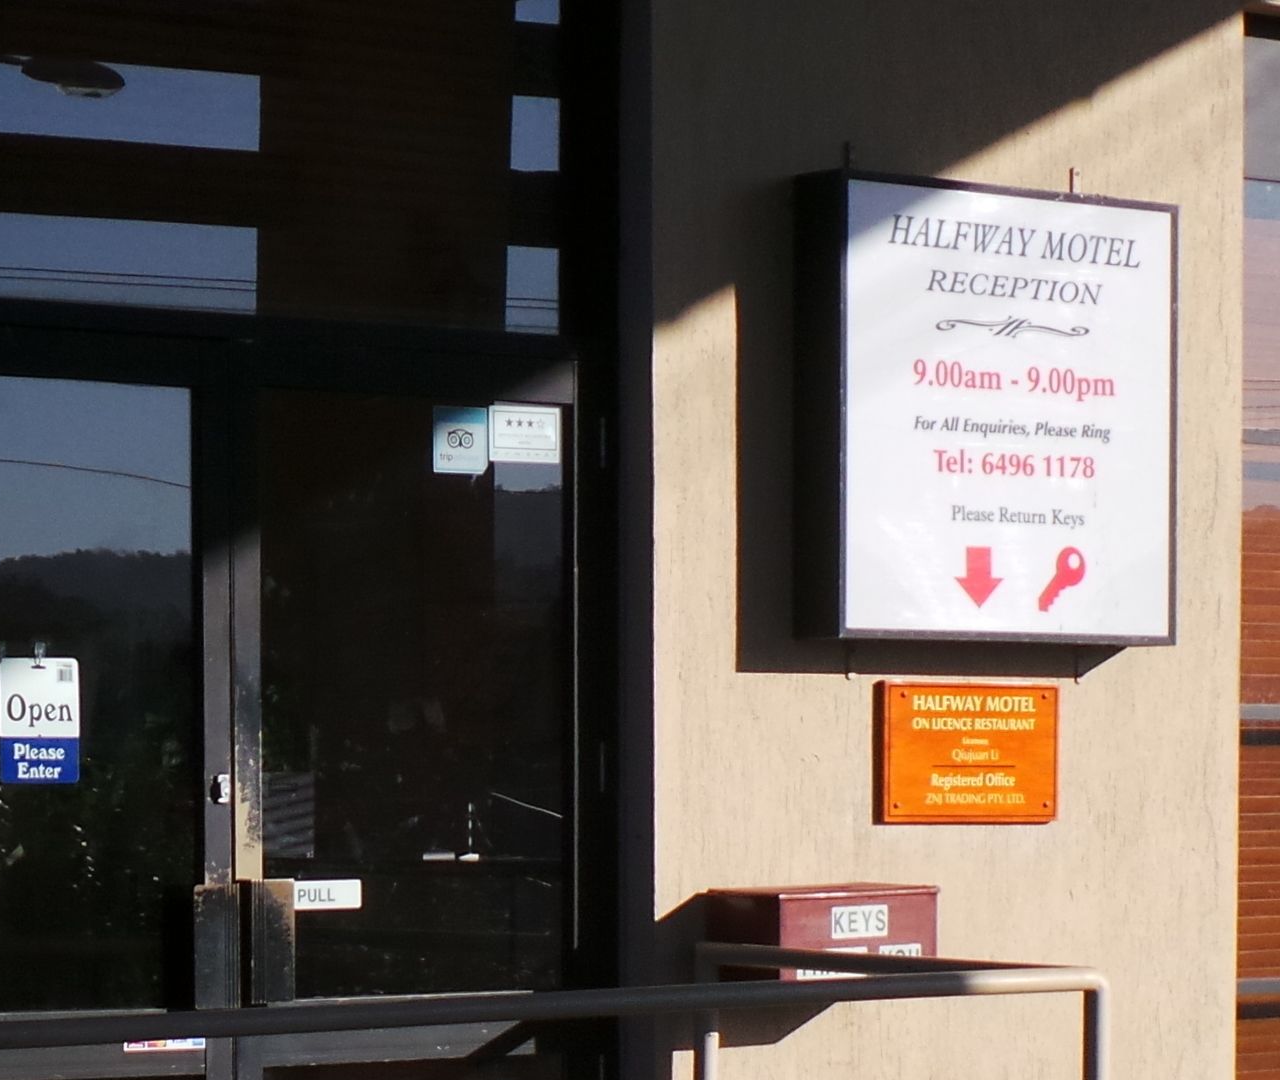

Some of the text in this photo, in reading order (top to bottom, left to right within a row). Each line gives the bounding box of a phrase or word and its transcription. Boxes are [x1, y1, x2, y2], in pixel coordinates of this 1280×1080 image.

[889, 214, 1141, 269] HALFWAY MOTEL
[926, 269, 1103, 305] RECEPTION
[912, 359, 1002, 391] 9.00am
[1027, 367, 1116, 401] 9.00pm
[913, 416, 1111, 443] For All Enquiries, Please Ring
[933, 449, 1095, 479] Tel: 6496 1178
[951, 505, 1085, 530] Please Return Keys
[7, 693, 73, 727] Open
[912, 695, 1036, 713] HALFWAY MOTEL
[912, 717, 1036, 731] ON LICENCE RESTAURANT
[13, 743, 65, 760] Please
[17, 762, 61, 779] Enter
[931, 772, 1016, 791] Registered Office
[944, 793, 986, 805] TRADING
[297, 888, 335, 902] PULL
[833, 909, 886, 934] KEYS
